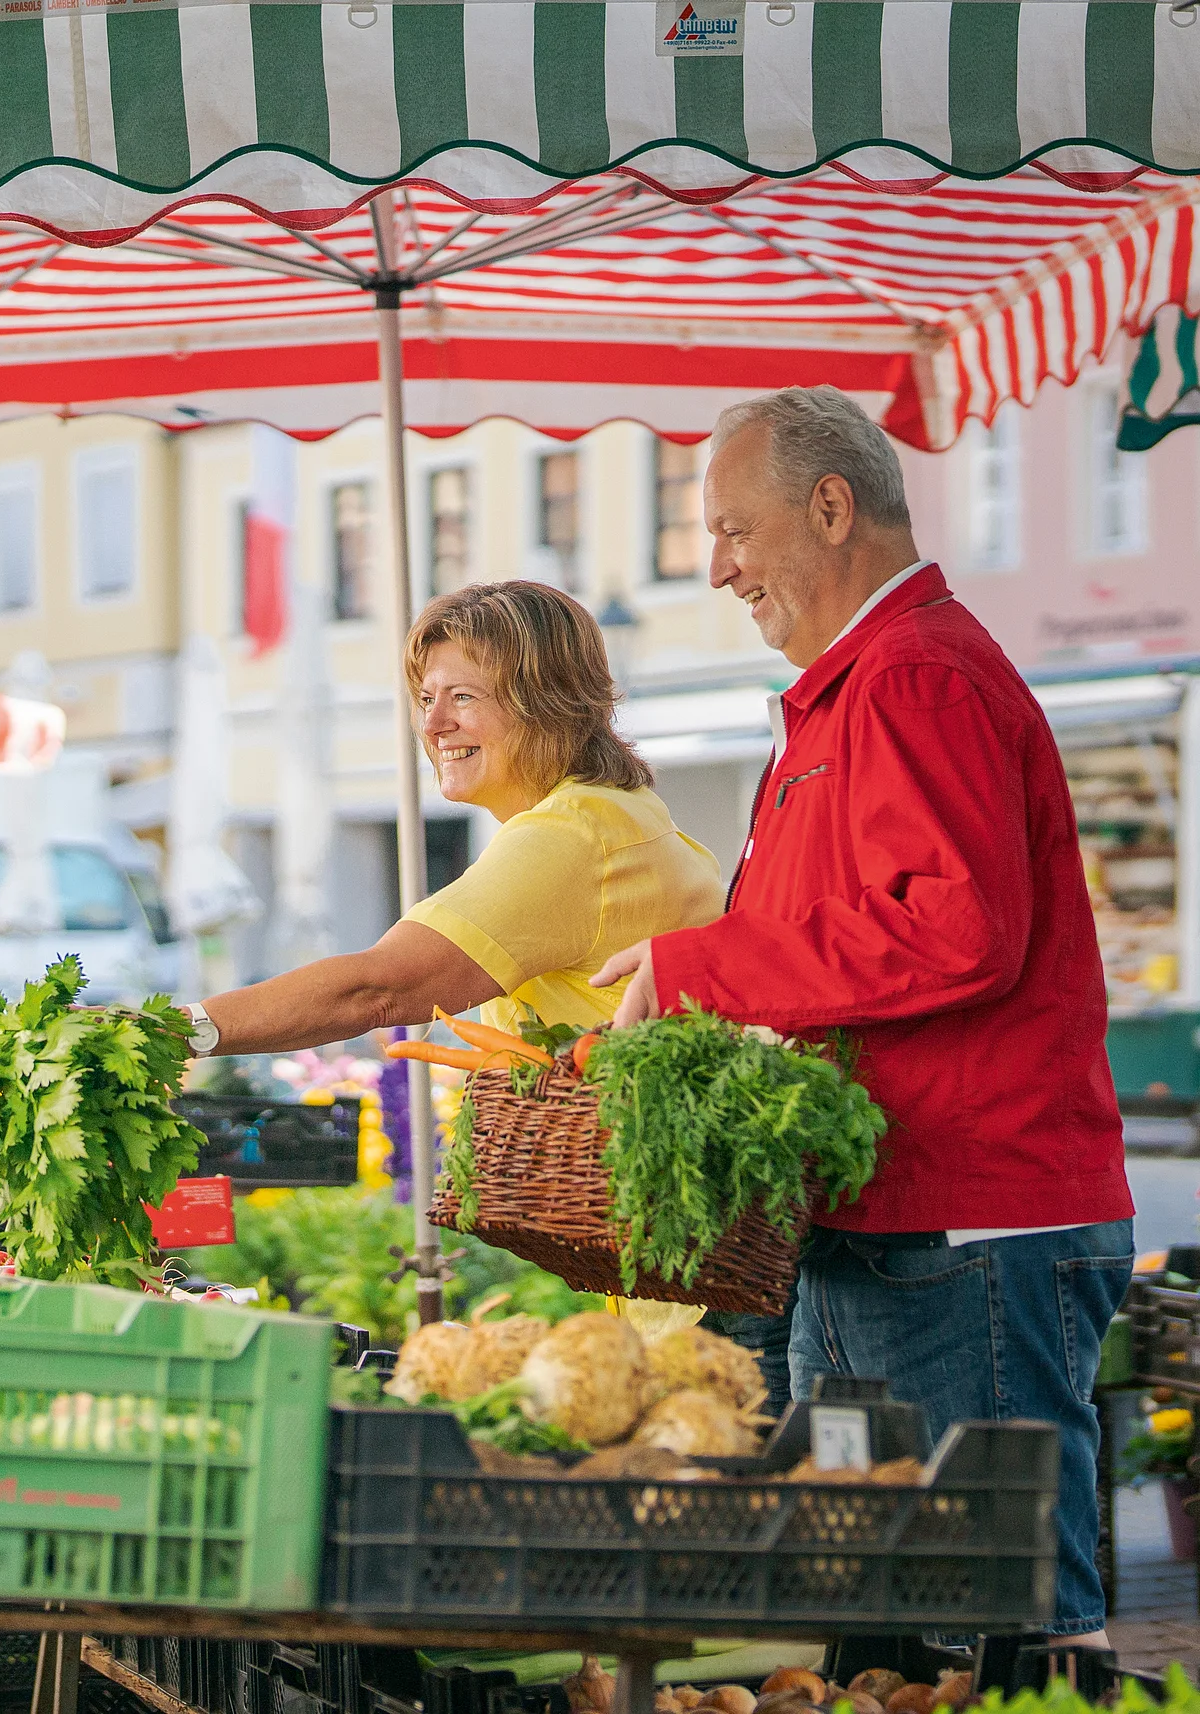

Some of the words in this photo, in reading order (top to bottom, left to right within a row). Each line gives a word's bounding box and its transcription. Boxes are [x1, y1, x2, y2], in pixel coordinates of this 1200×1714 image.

[5, 1, 42, 13] PARASOLS
[47, 0, 80, 10] LAMBERT
[678, 19, 737, 33] LAMBERT
